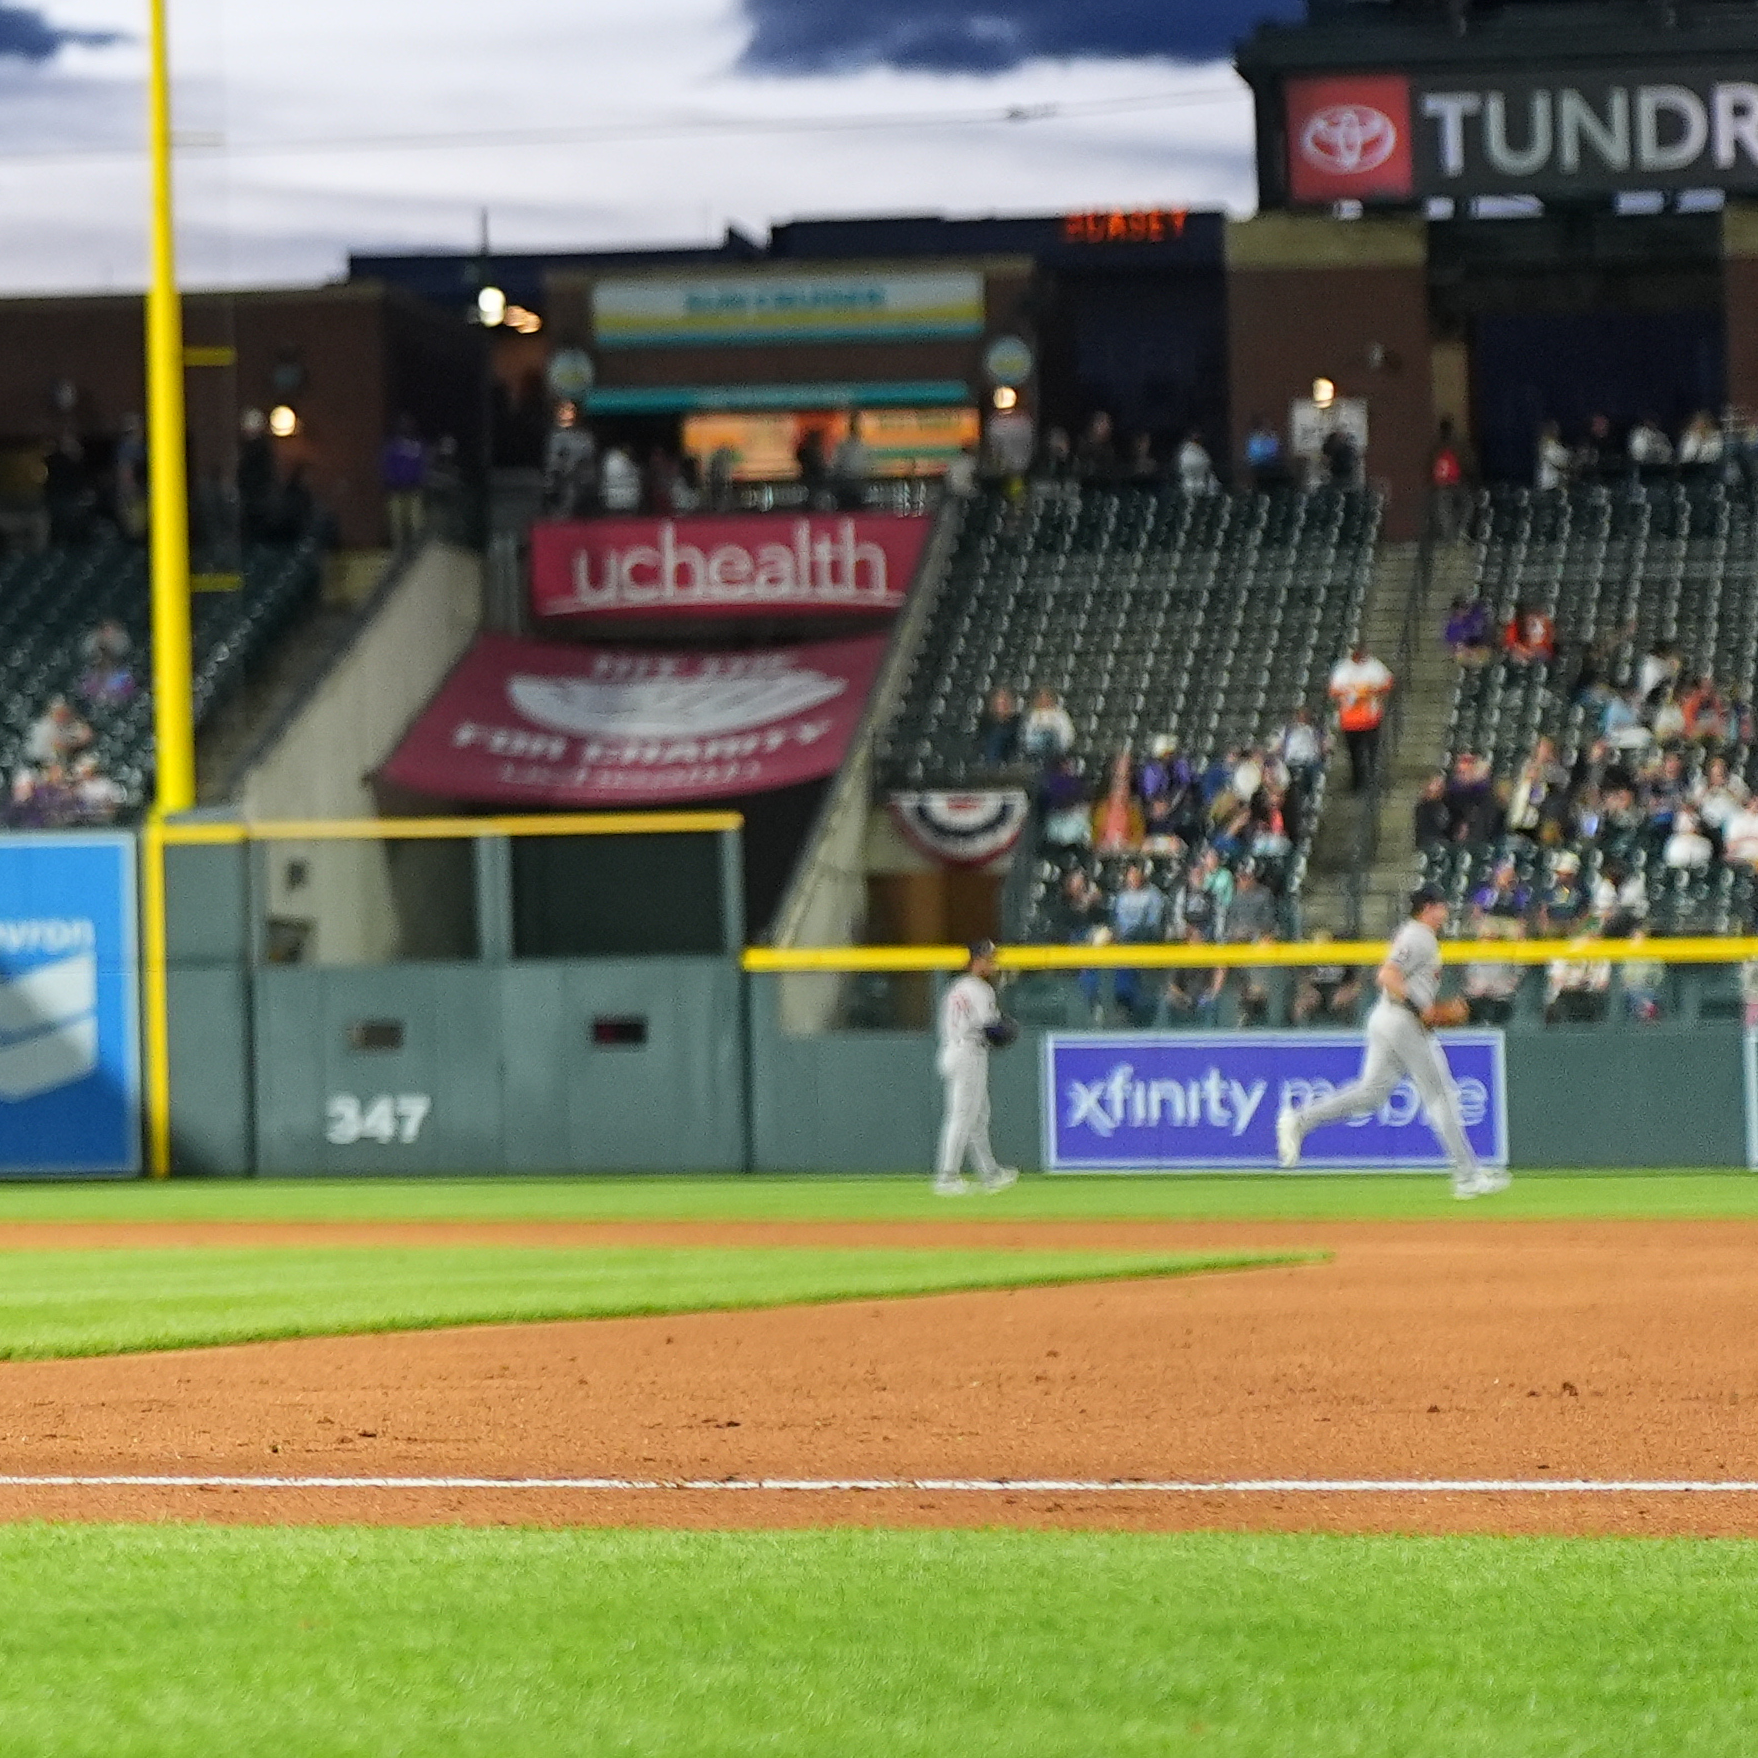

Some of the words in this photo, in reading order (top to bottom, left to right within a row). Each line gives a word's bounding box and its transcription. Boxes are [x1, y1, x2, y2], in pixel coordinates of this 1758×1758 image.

[572, 517, 889, 601] uchealth
[327, 1092, 432, 1144] 347
[1065, 1061, 1269, 1138] xfinity
